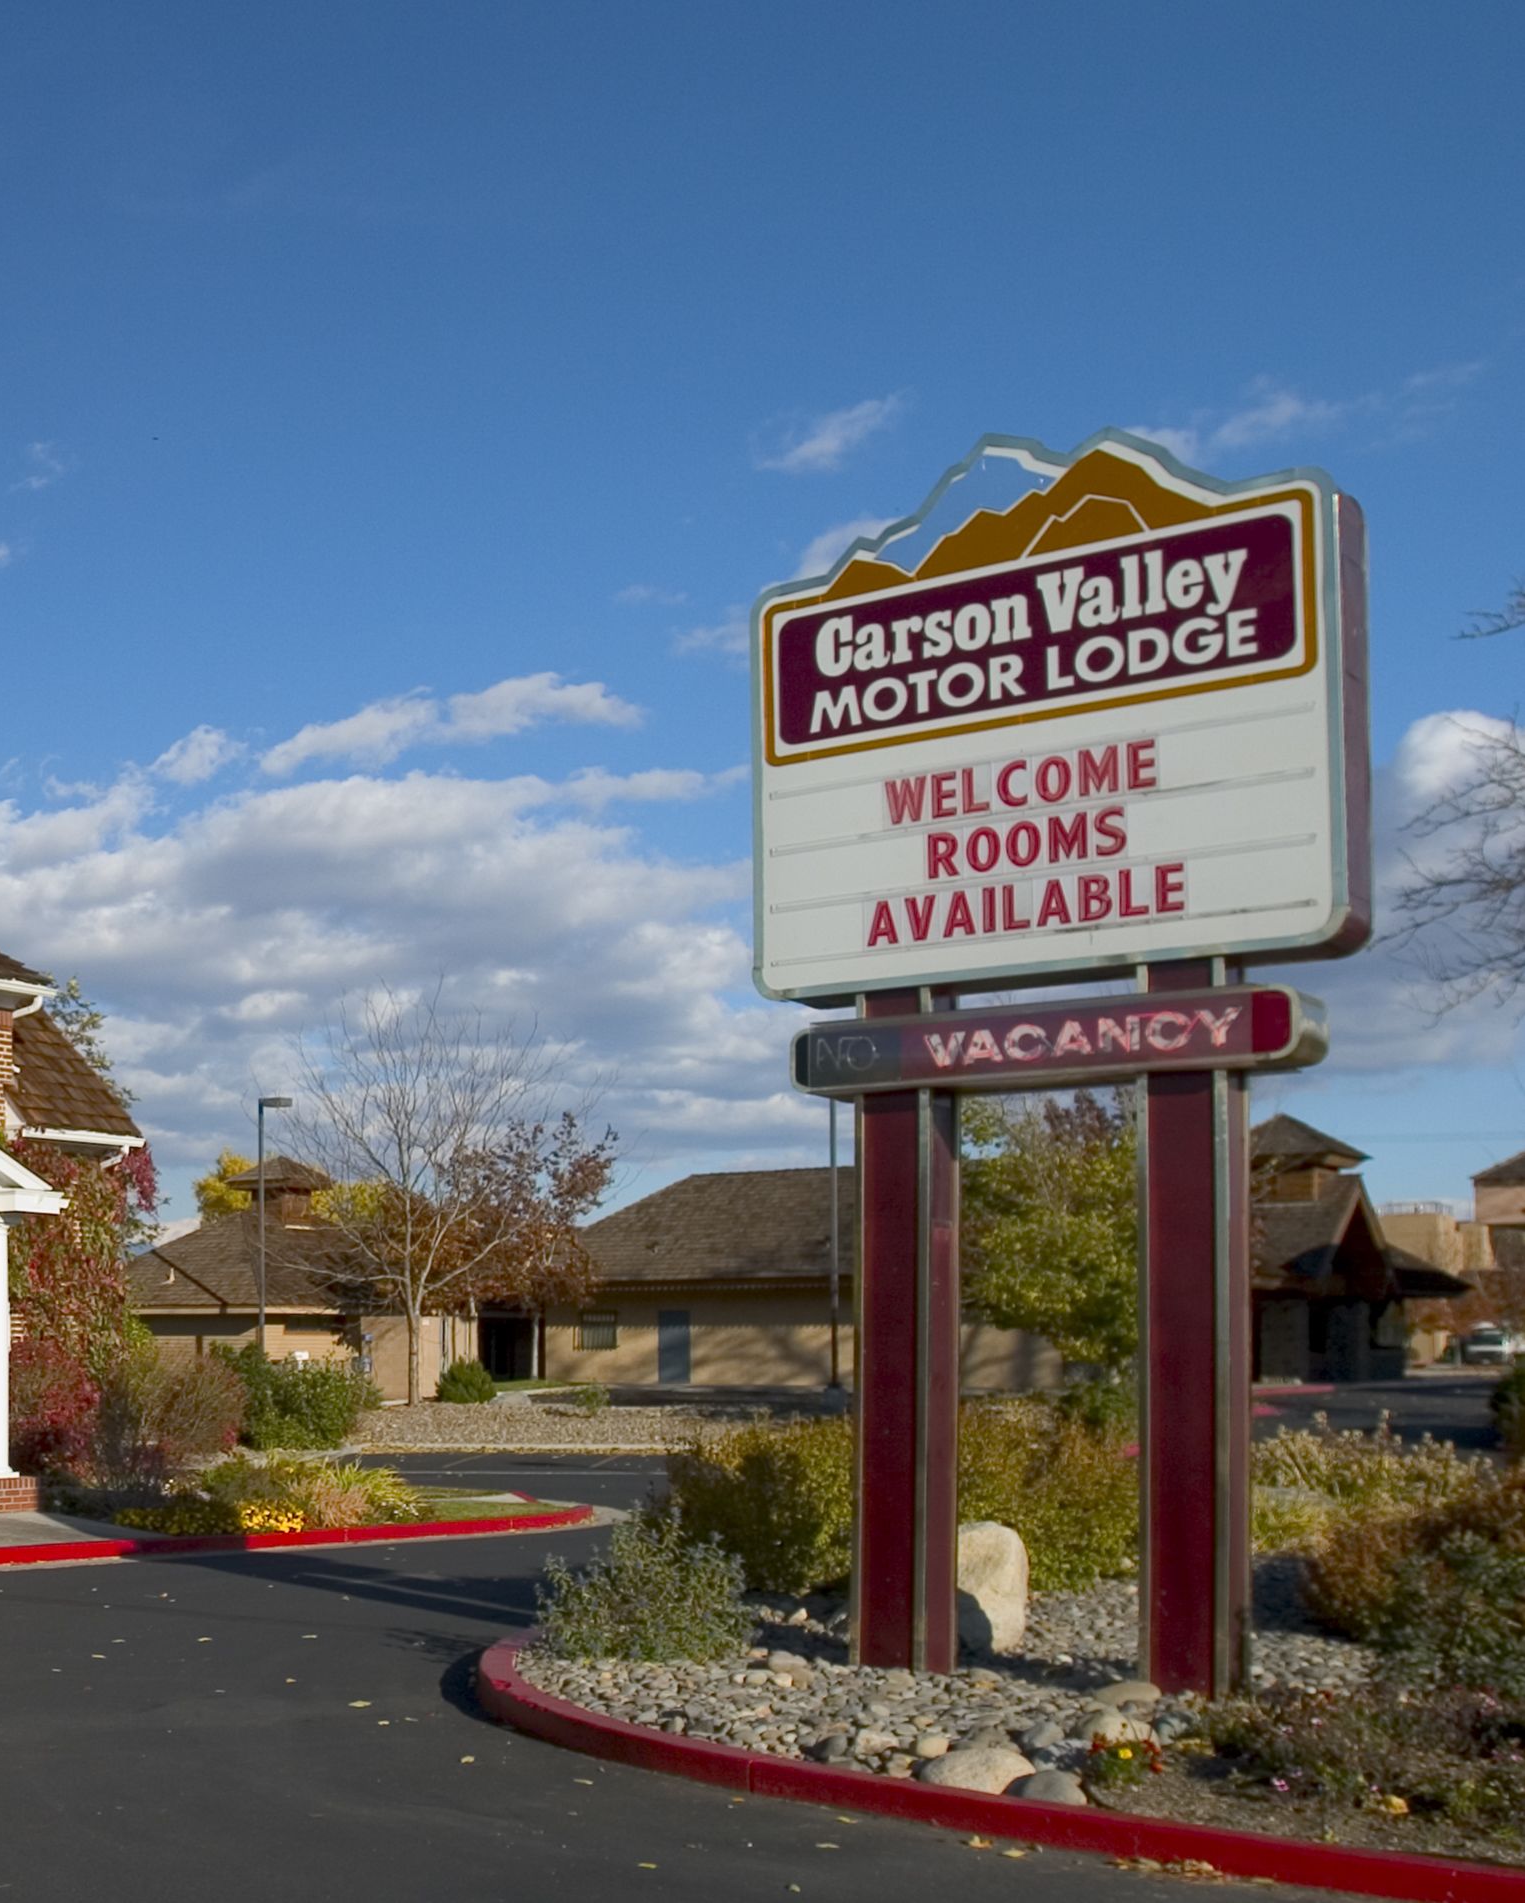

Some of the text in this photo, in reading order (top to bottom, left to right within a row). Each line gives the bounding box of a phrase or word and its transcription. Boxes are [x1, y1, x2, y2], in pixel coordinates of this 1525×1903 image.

[815, 548, 1248, 677] Carson Valley
[809, 608, 1258, 733] MOTOR LODGE
[885, 738, 1157, 825] WELCOME
[927, 805, 1127, 880] ROOMS
[867, 862, 1185, 947] AVAILABLE
[816, 1005, 1243, 1071] NO VACANCY
